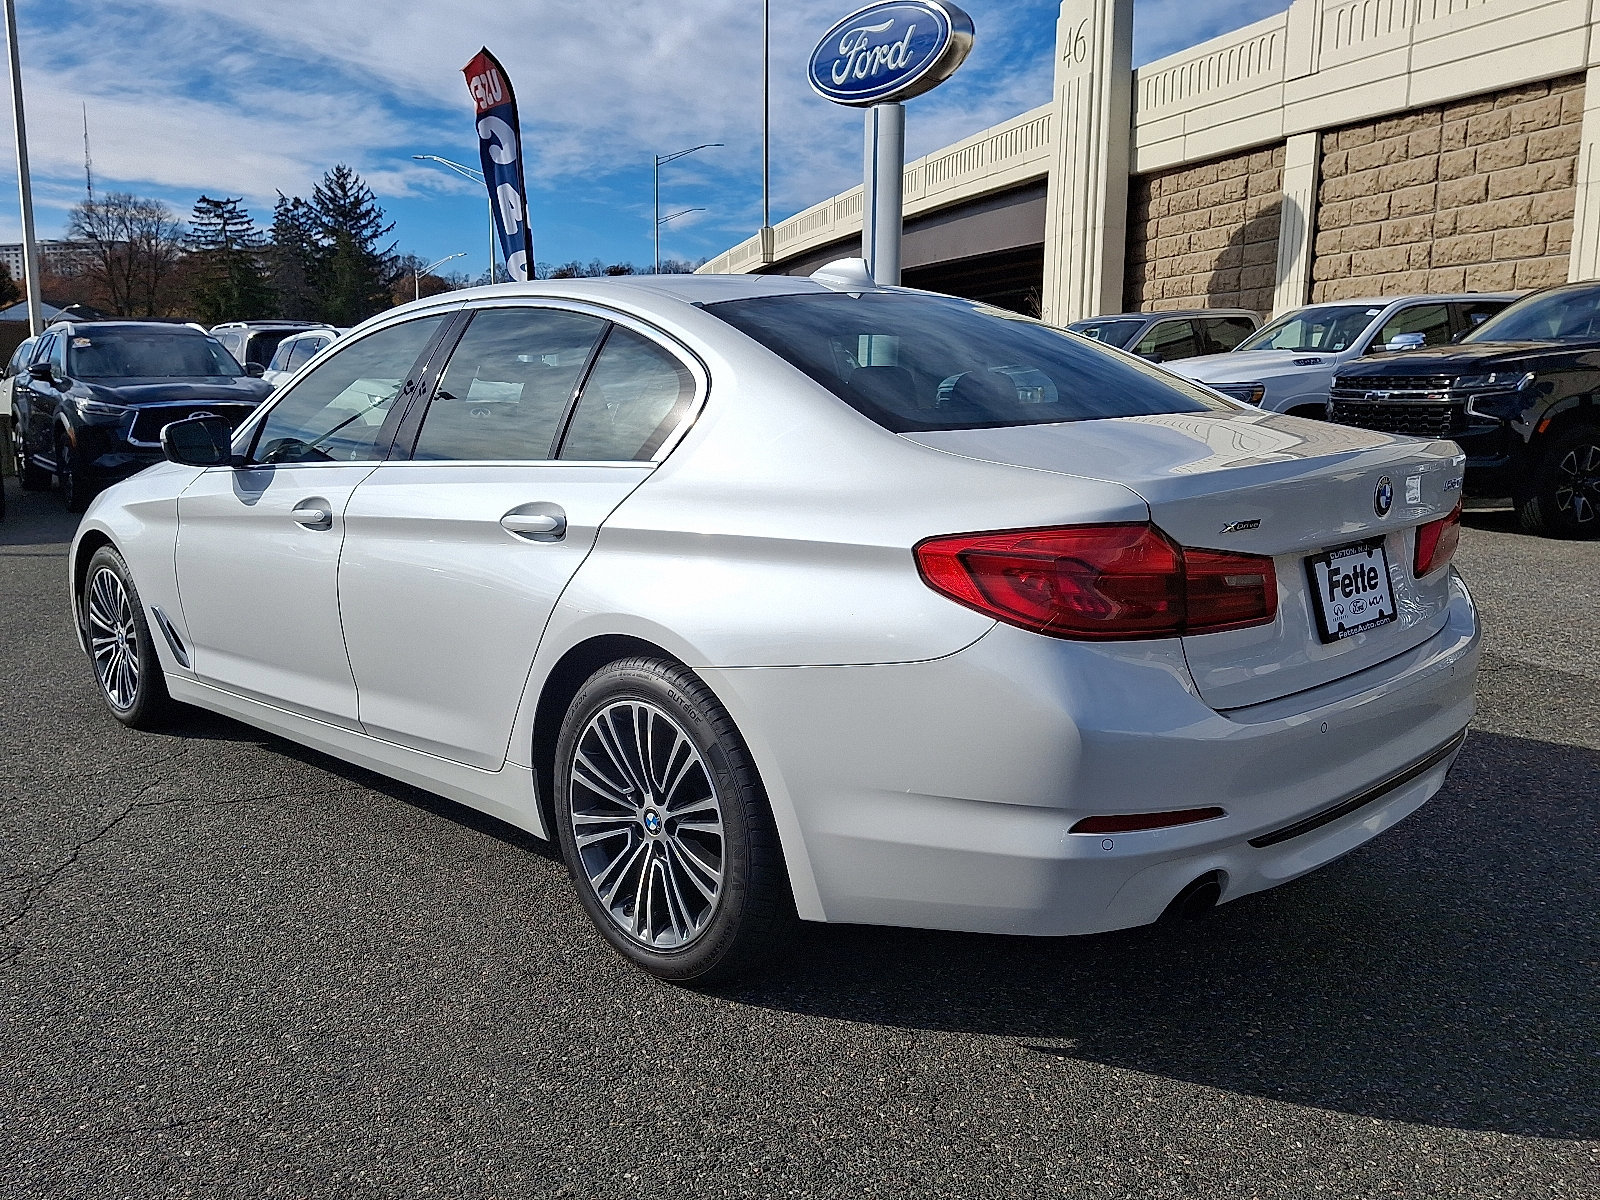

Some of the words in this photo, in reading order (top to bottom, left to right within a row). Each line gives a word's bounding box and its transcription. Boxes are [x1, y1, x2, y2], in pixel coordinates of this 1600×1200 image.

[831, 18, 917, 86] Ford
[1062, 17, 1089, 69] 46
[1327, 562, 1379, 603] Fette
[1338, 617, 1391, 639] FetteAuto.com
[667, 689, 704, 726] OUTSIDE
